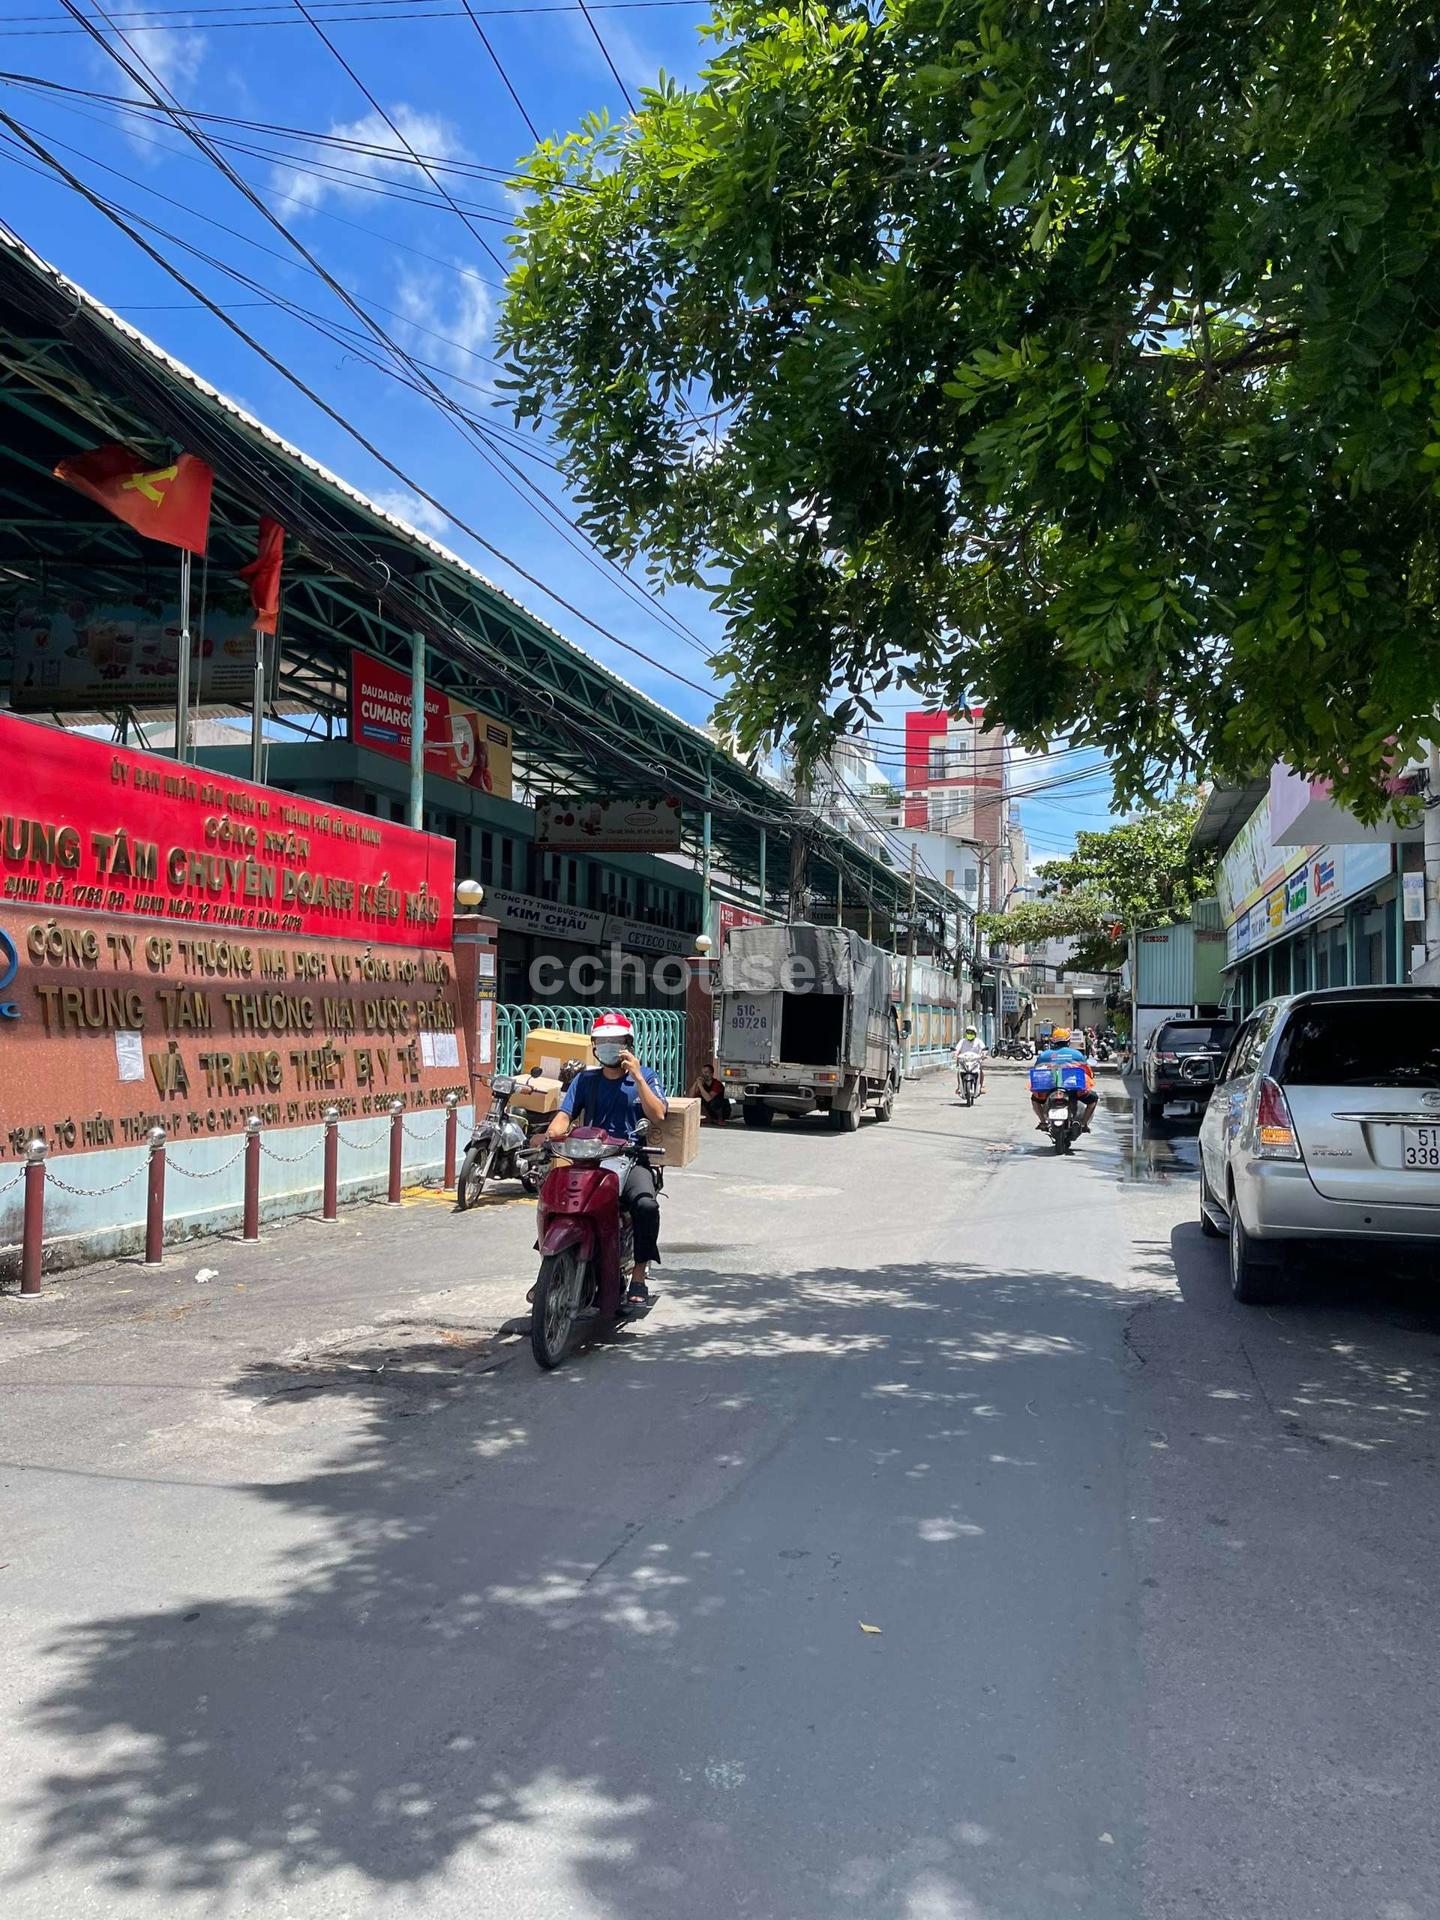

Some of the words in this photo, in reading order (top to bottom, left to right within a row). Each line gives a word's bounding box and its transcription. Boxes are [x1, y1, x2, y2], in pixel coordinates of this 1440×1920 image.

[134, 766, 161, 791] BAN
[204, 814, 258, 846] CÔNG
[0, 815, 81, 869] UNG
[91, 827, 159, 881] TÂM
[167, 846, 277, 899] CHUYÊN
[282, 868, 354, 911] DOANH
[506, 905, 541, 922] KIM
[27, 918, 99, 960] CÔNG
[106, 932, 138, 962] TY
[178, 938, 253, 972] THƯƠNG
[628, 931, 665, 949] CETECO
[35, 984, 145, 1029] TRUNG
[156, 981, 215, 1029] TÂM
[224, 990, 315, 1031] THƯƠNG
[148, 1041, 191, 1091] VÀ
[199, 1050, 282, 1087] TRANG
[290, 1035, 346, 1082] THIẾT
[377, 1048, 391, 1077] Y
[1418, 1129, 1437, 1147] 51
[1406, 1147, 1439, 1165] 338
